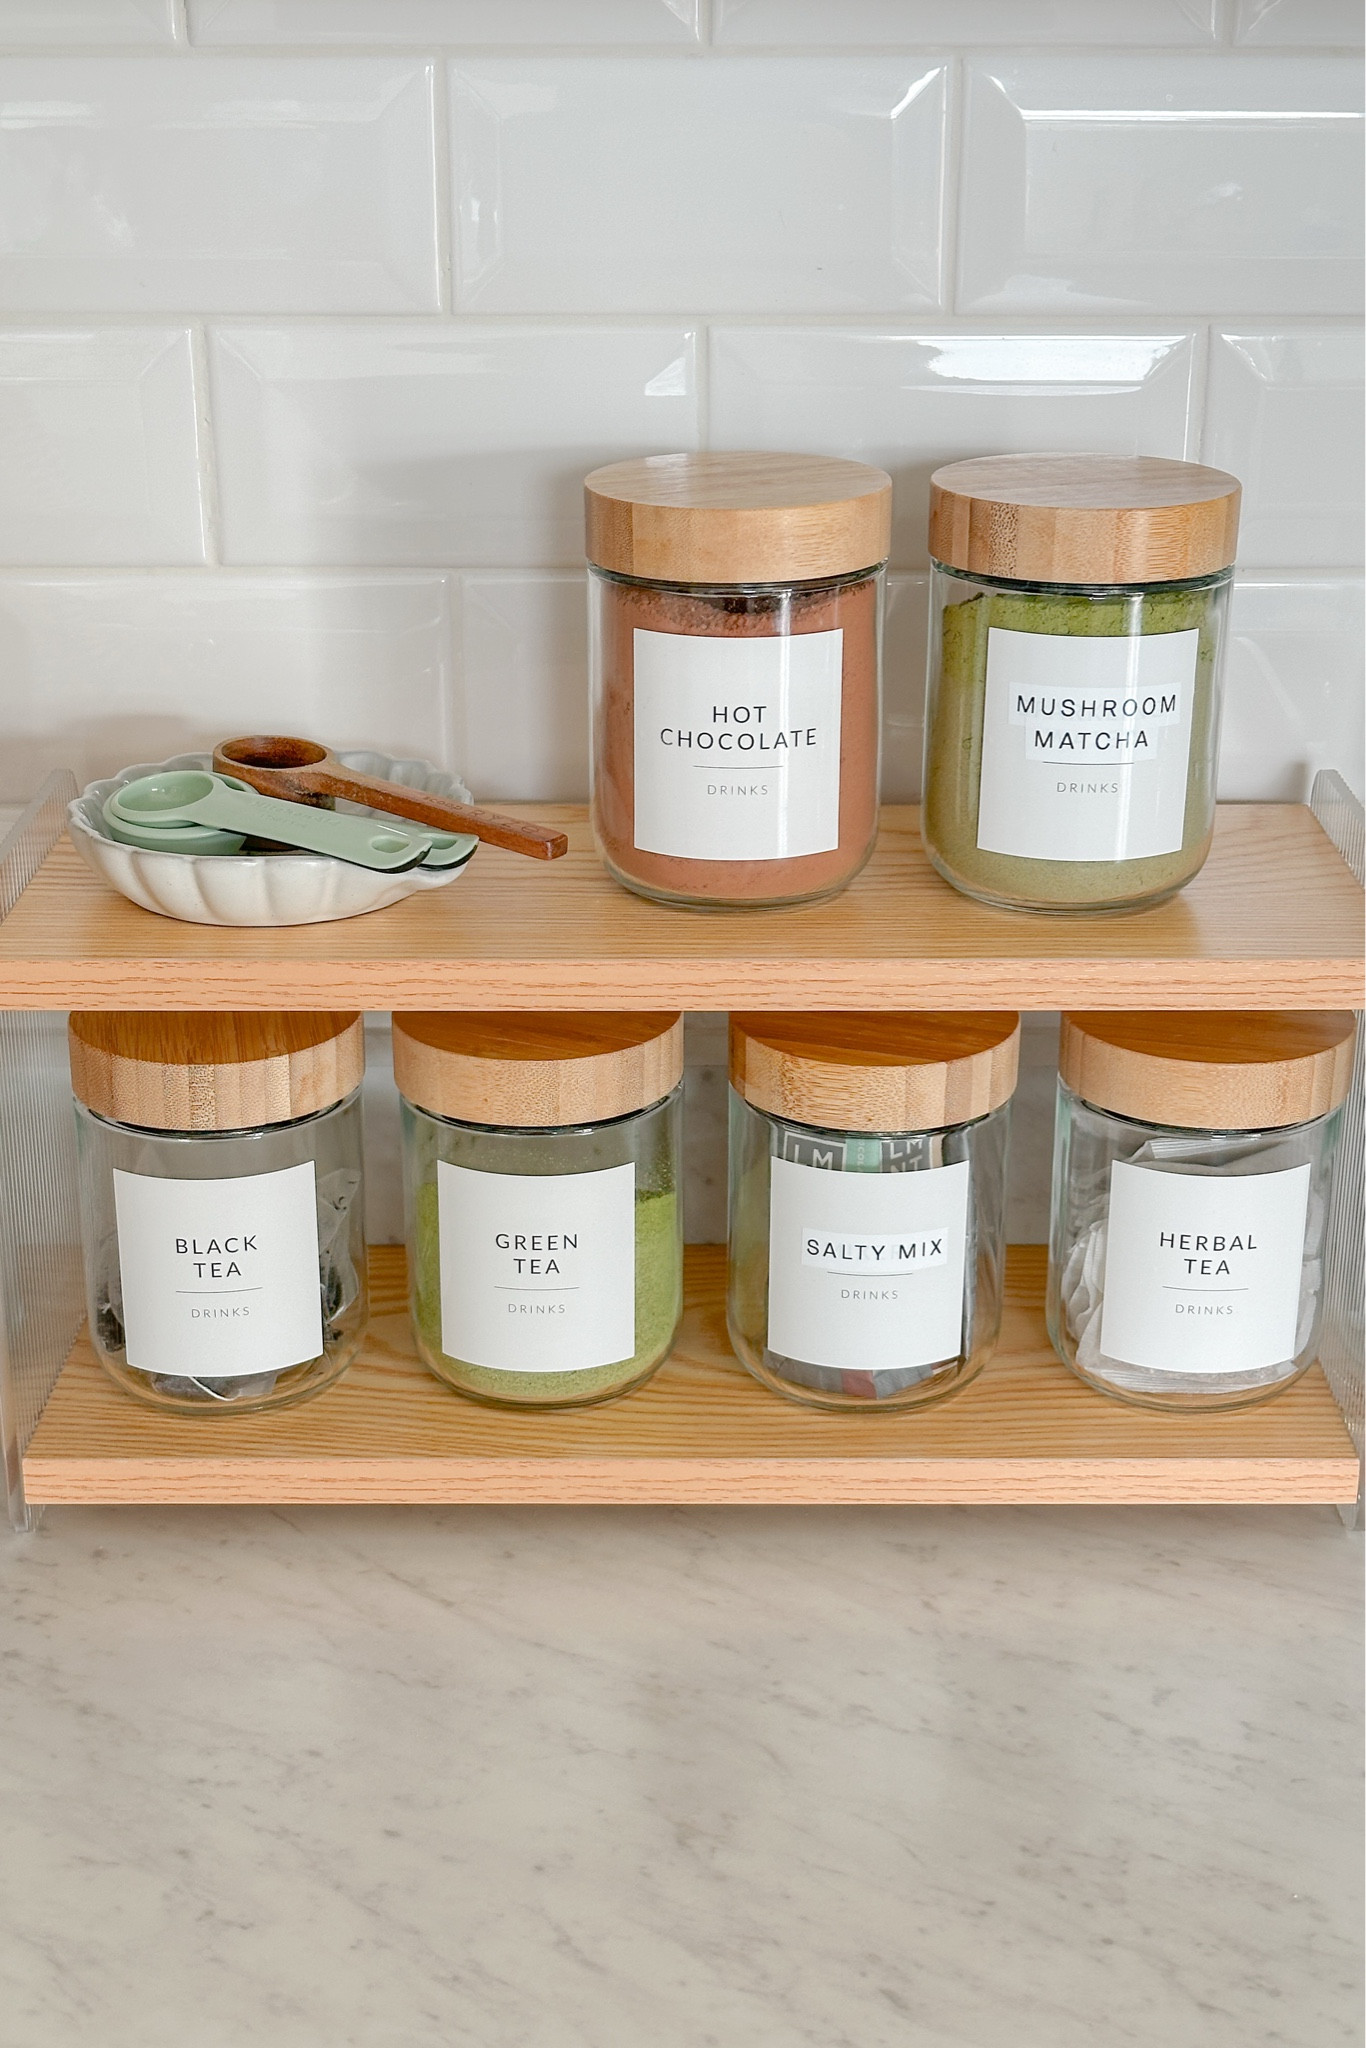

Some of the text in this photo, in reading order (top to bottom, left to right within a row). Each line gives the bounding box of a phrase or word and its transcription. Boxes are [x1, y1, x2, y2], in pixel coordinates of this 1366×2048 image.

[712, 705, 768, 724] HOT
[1016, 694, 1177, 718] MUSHROOM
[660, 727, 817, 751] CHOCOLATE
[1034, 729, 1149, 751] MATCHA
[707, 784, 768, 796] DRINKS
[1056, 781, 1119, 794] DRINKS
[175, 1234, 258, 1255] BLACK
[495, 1233, 578, 1251] GREEN
[806, 1238, 943, 1261] SALTY MIX
[1159, 1231, 1258, 1252] HERBAL
[192, 1261, 242, 1279] TEA
[512, 1257, 561, 1275] TEA
[1183, 1258, 1231, 1276] TEA
[840, 1289, 899, 1301] DRINKS
[191, 1306, 250, 1319] DRINKS
[507, 1303, 566, 1315] DRINKS
[1175, 1303, 1233, 1316] DRINKS
